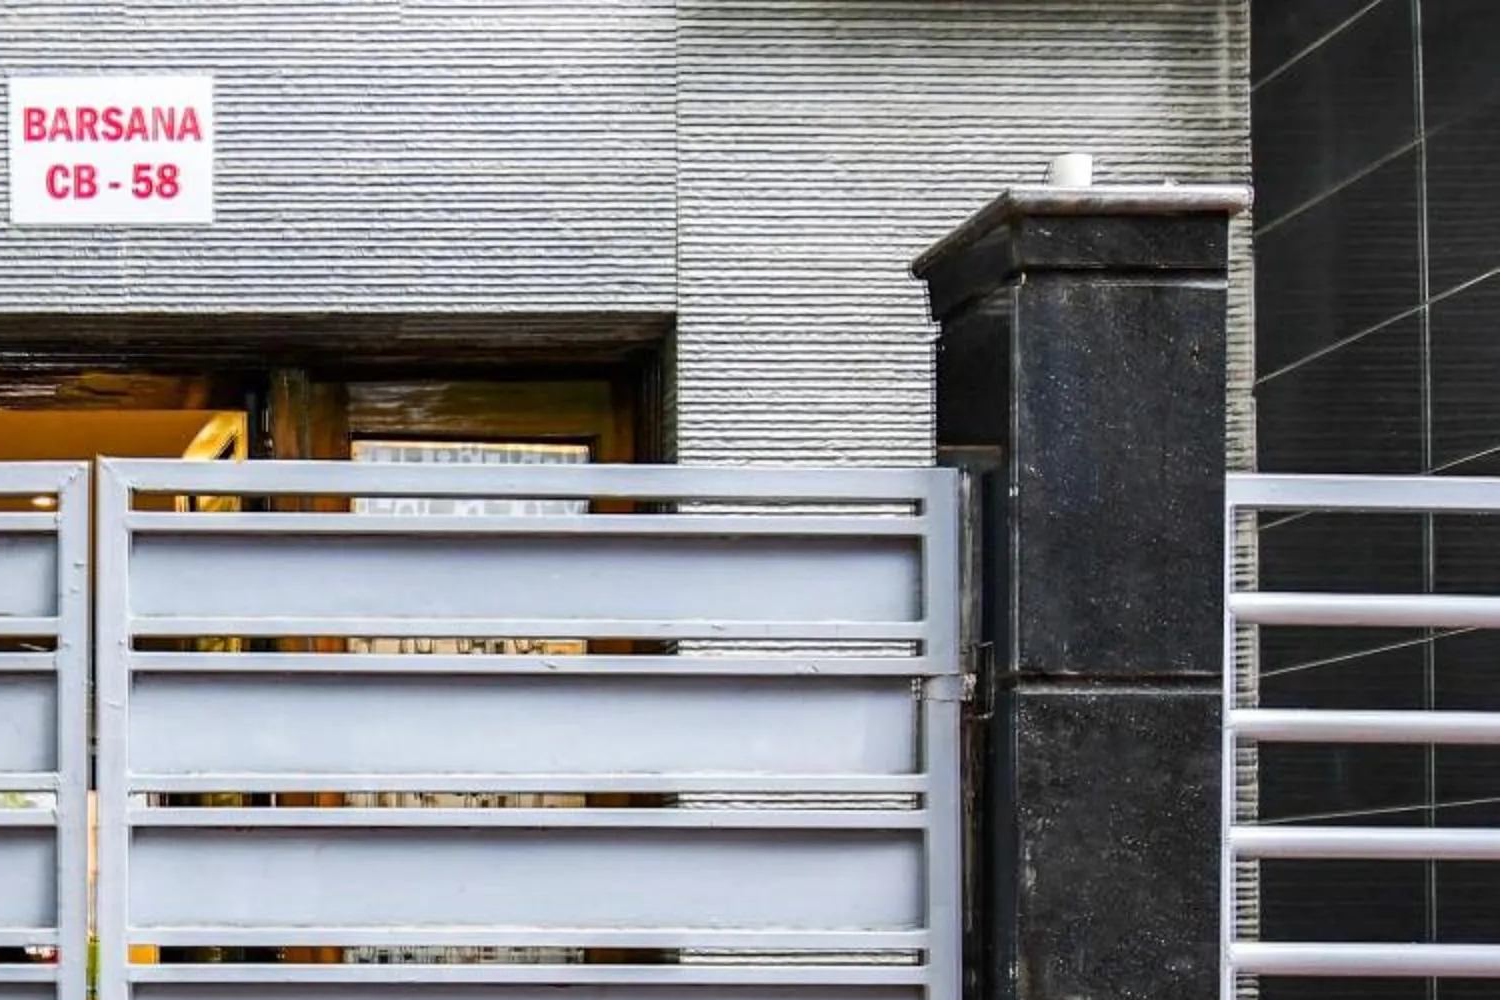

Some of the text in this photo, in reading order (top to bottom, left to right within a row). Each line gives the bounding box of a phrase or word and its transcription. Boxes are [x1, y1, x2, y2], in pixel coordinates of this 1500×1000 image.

[23, 106, 202, 142] BARSANA
[45, 163, 99, 200] CB
[131, 163, 181, 200] 58
